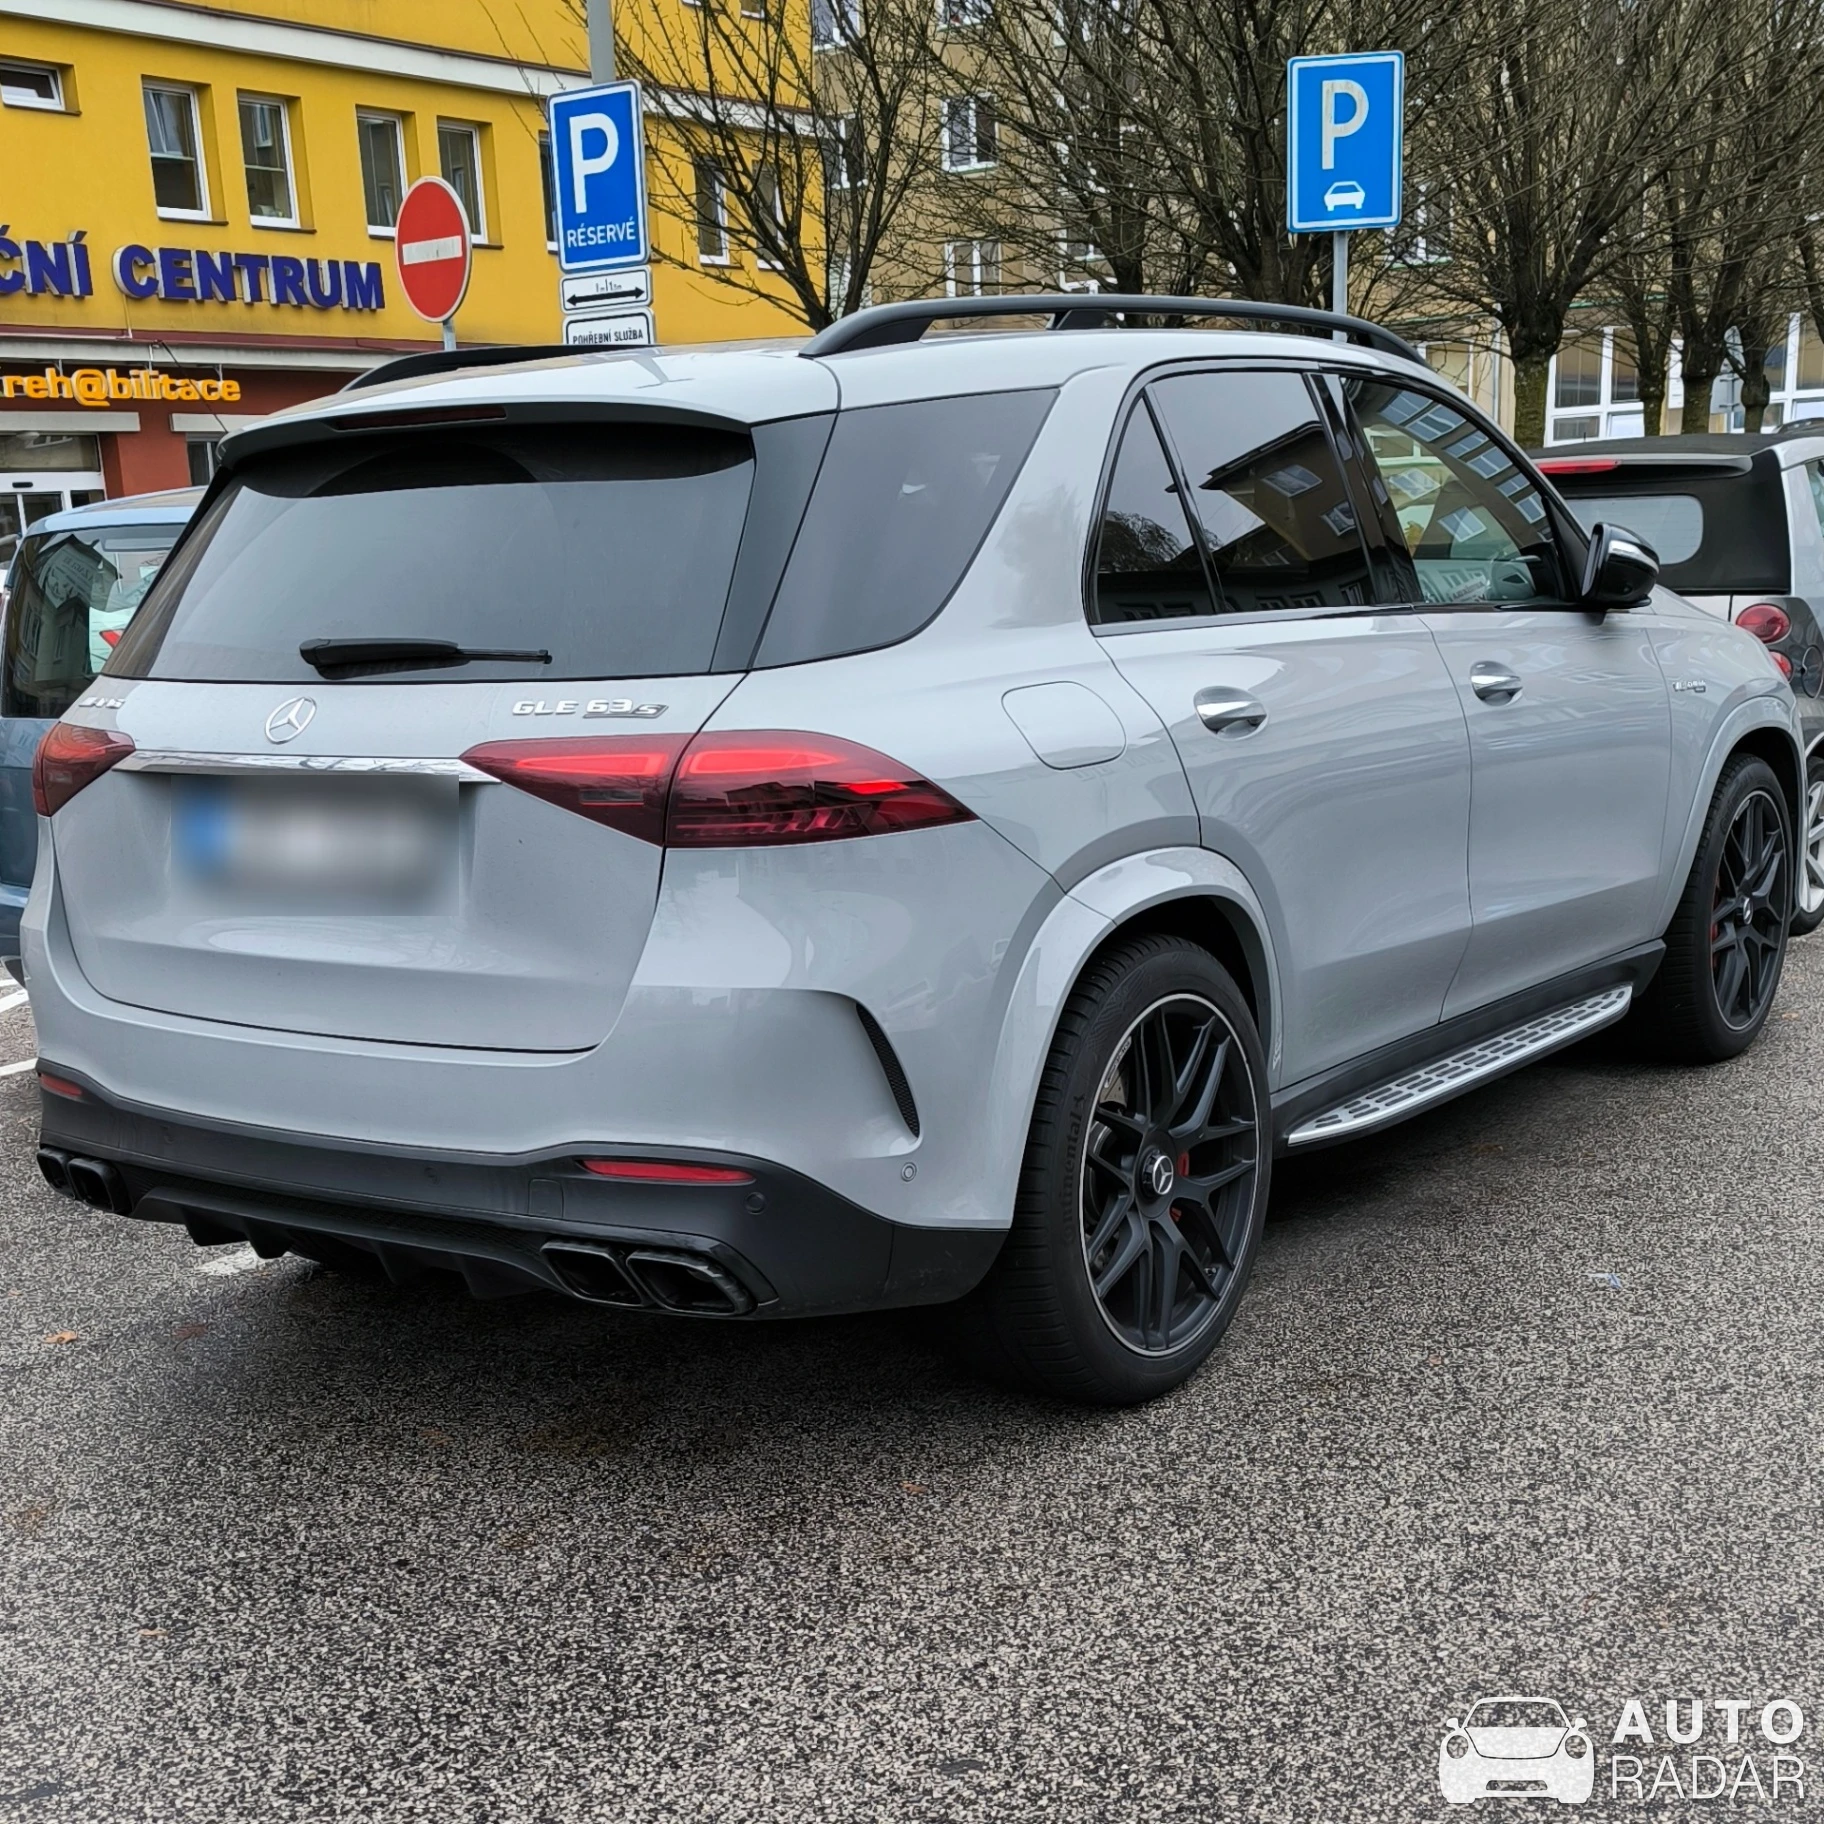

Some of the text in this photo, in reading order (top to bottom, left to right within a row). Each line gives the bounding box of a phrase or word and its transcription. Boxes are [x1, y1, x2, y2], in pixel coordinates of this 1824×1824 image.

[1321, 79, 1369, 170] P
[569, 112, 619, 214] P
[566, 216, 637, 248] RÉSERVÉ
[113, 243, 386, 311] CENTRUM
[572, 327, 644, 344] POHŘEBNÍ SLUŽBA
[2, 366, 242, 407] reh@bilitace
[512, 700, 579, 716] GLE
